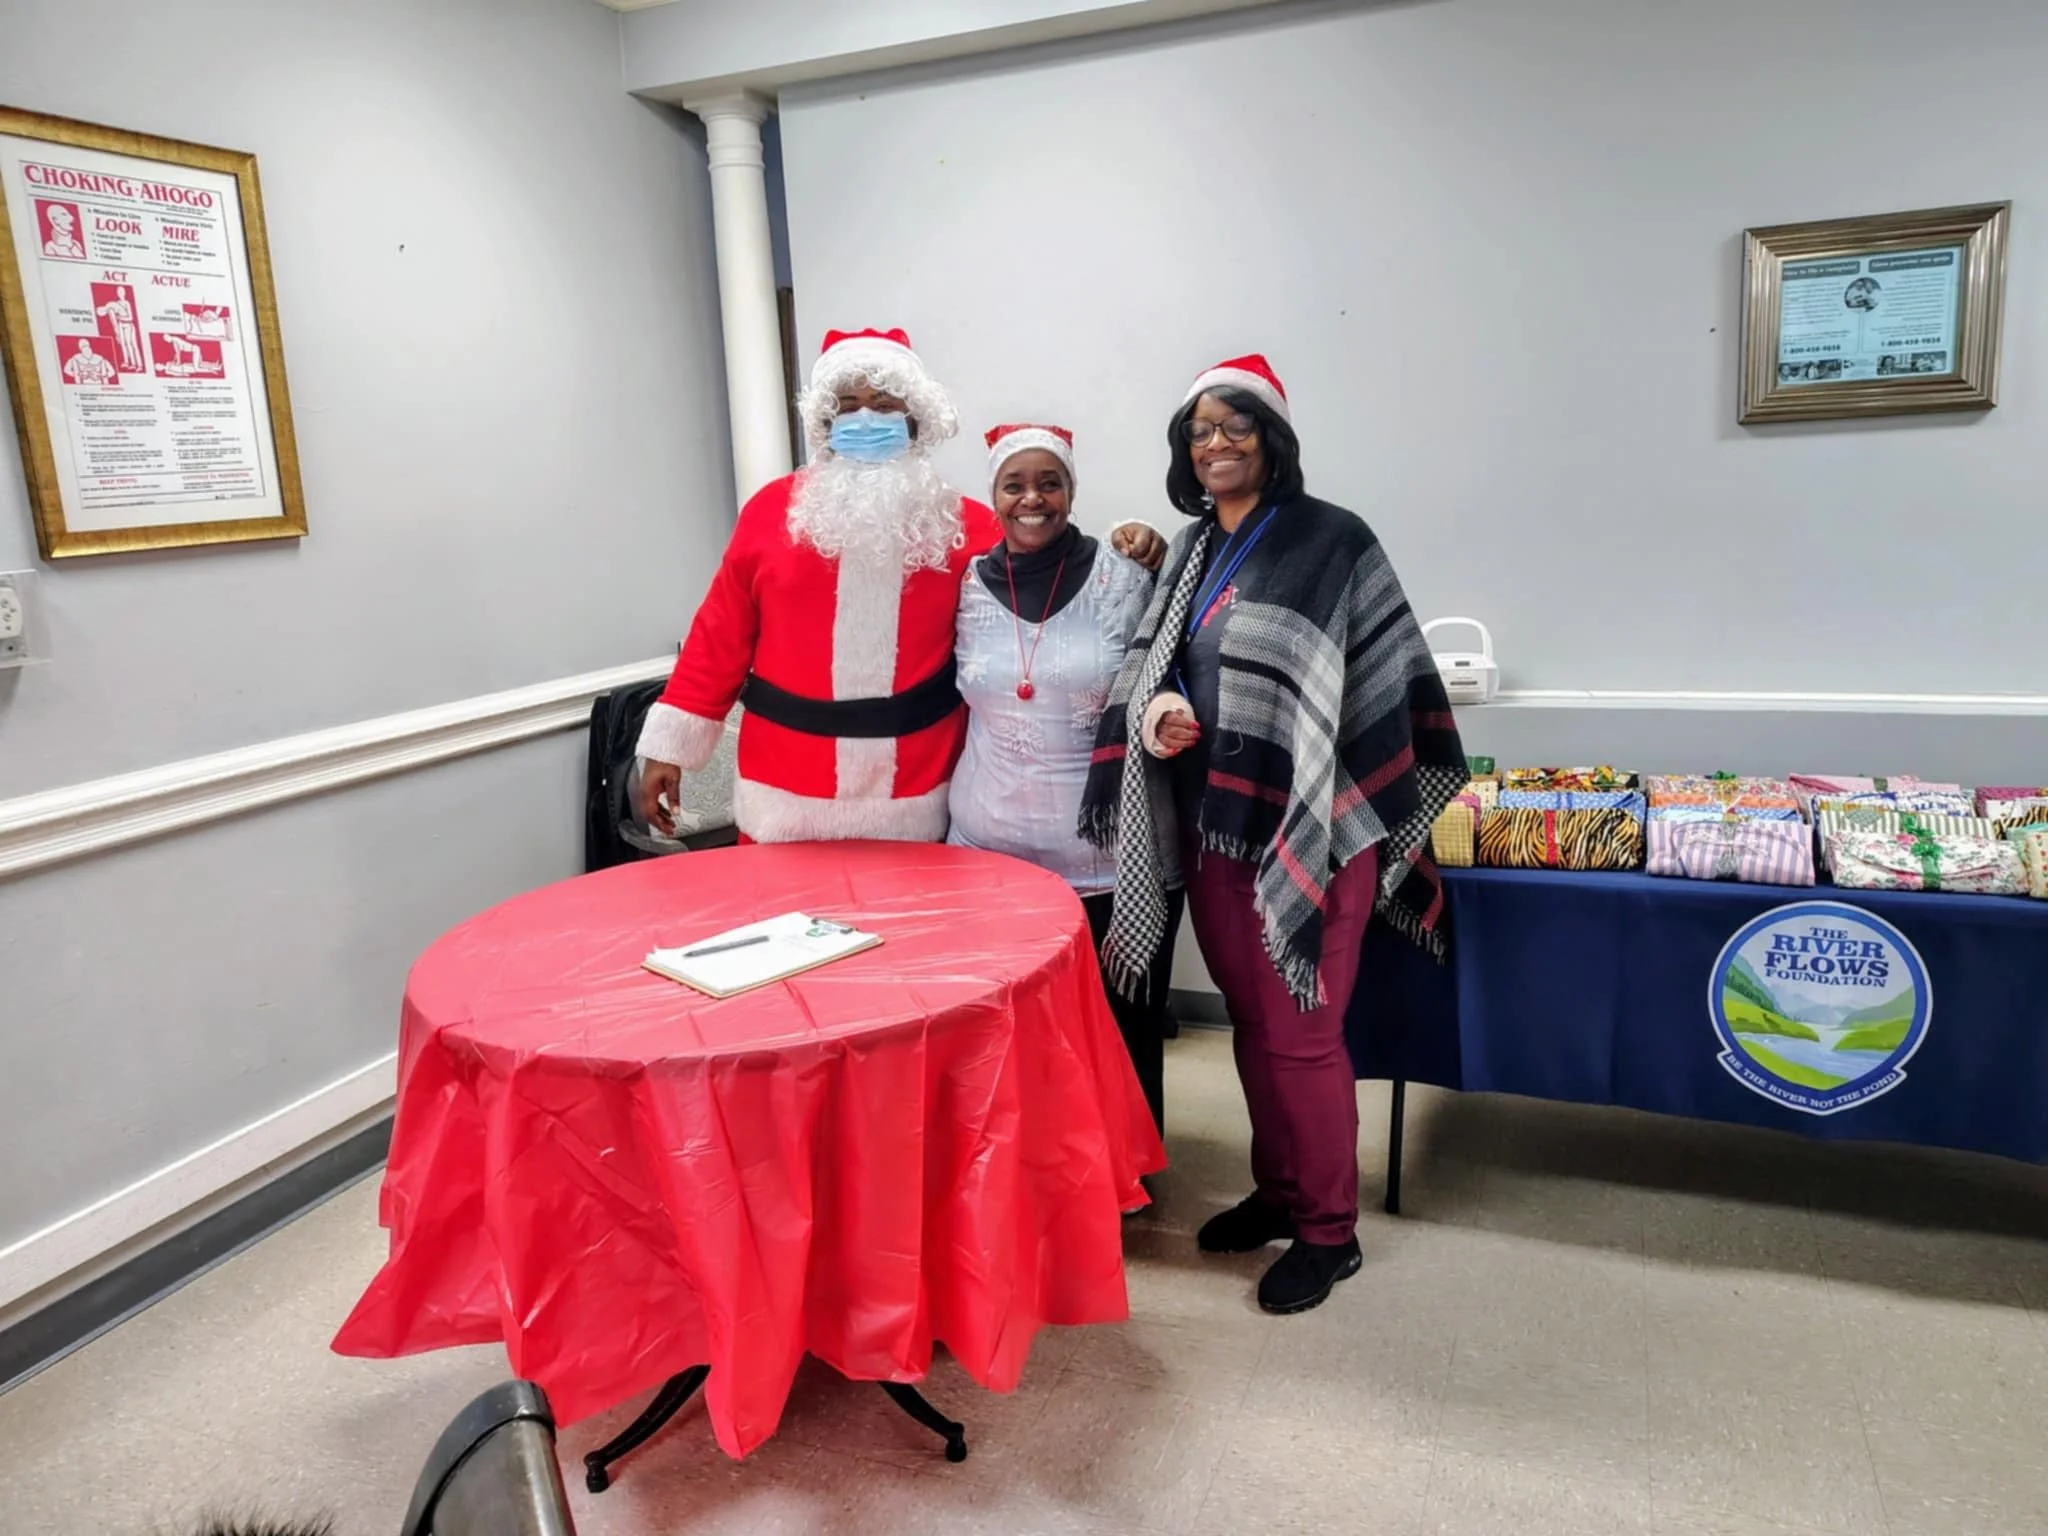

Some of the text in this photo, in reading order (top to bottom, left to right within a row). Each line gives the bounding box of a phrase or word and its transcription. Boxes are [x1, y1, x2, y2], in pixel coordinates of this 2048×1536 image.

[25, 164, 134, 197] CHOKING
[140, 182, 213, 208] AHOGO
[95, 217, 143, 235] LOOK
[162, 226, 200, 242] MIRE
[102, 269, 128, 283] ACT
[151, 274, 191, 288] ACTUE
[1809, 926, 1849, 940] THE
[1771, 933, 1887, 959] RIVER
[1764, 951, 1889, 978] FLOWS
[1765, 968, 1887, 988] FOUNDATION
[1725, 1053, 1898, 1109] BE THE RIVER NOT THE POND
